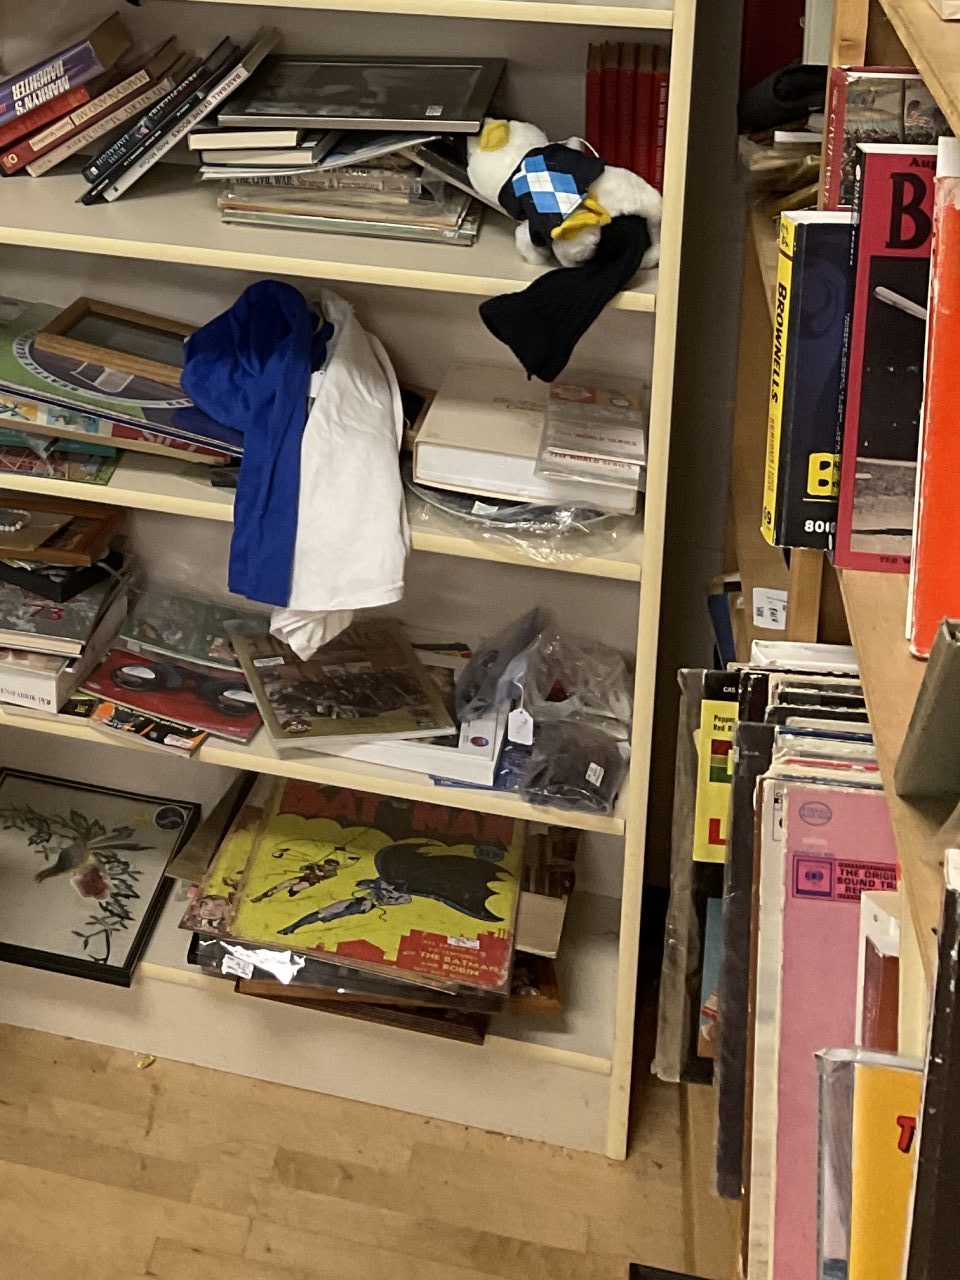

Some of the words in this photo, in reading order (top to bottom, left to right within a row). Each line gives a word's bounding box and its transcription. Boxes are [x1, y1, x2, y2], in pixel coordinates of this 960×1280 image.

[11, 60, 65, 101] DAUGHTER
[15, 75, 70, 116] MARILYN'S
[212, 72, 242, 100] BASEBALL
[171, 118, 192, 138] BOOKS
[95, 134, 130, 166] LIMBAUGH
[770, 282, 788, 404] BROWNELLS
[837, 878, 876, 888] SOUND
[839, 868, 861, 877] THE
